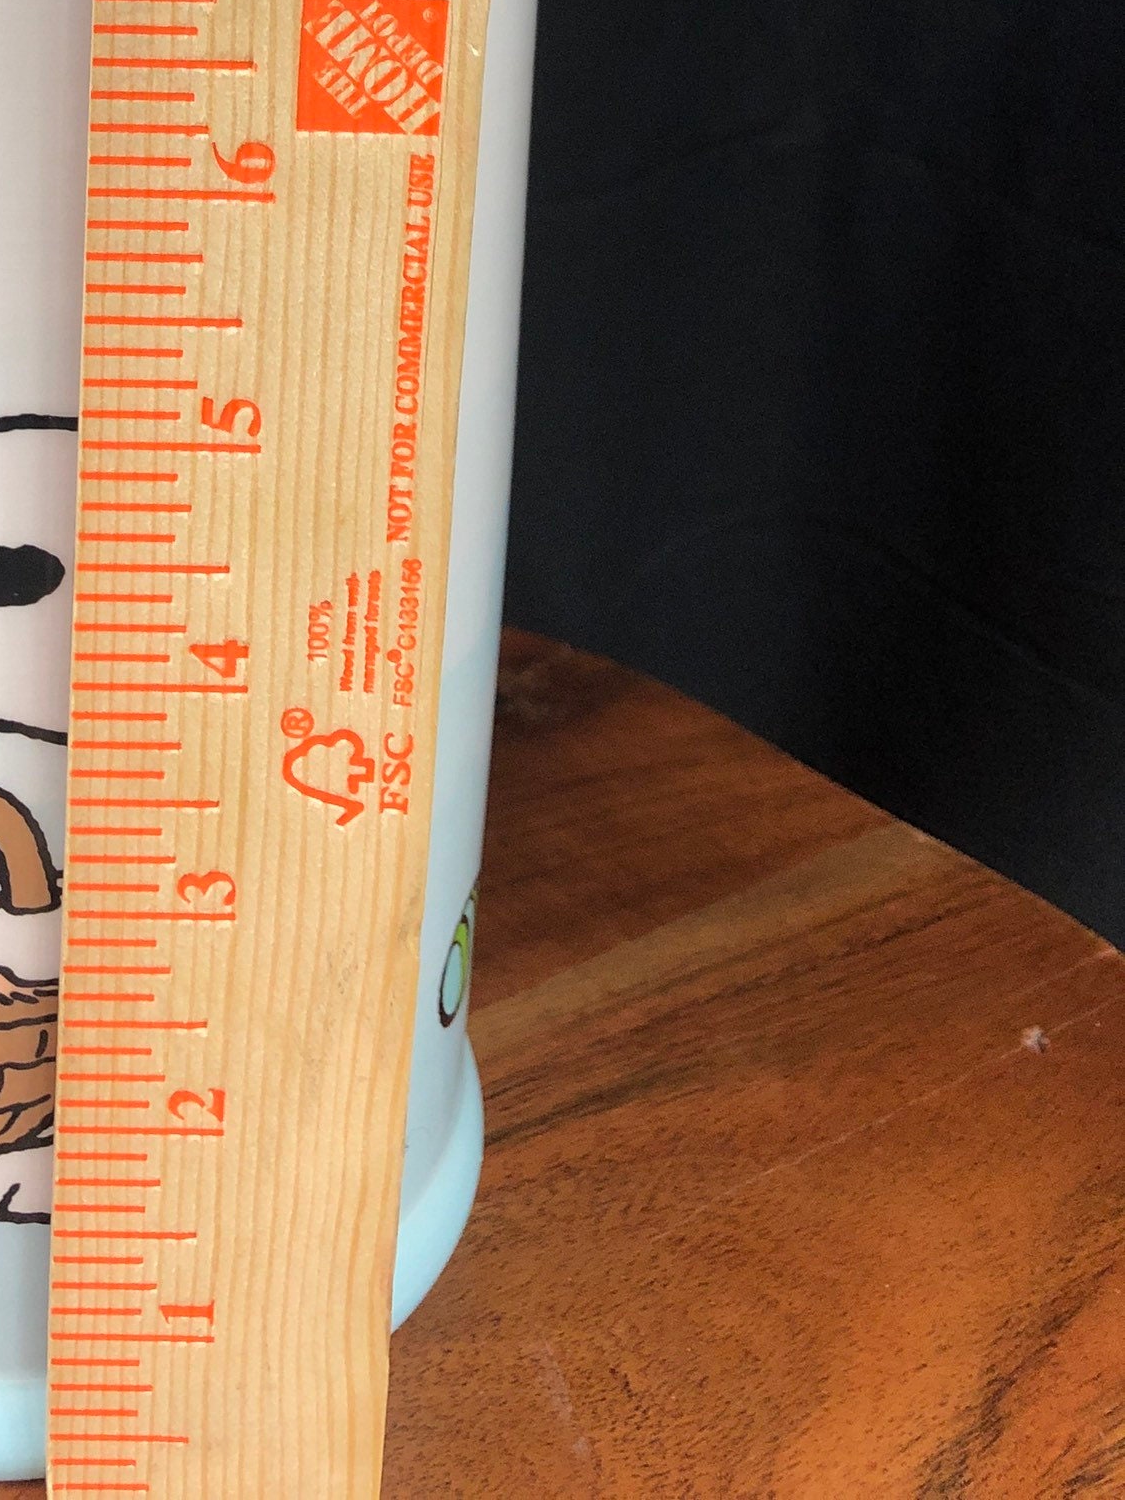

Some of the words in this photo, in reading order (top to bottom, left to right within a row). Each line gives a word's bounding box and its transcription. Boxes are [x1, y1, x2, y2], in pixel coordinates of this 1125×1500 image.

[304, 0, 440, 134] HOME
[357, 0, 443, 85] DEPOT
[314, 61, 369, 118] THE
[210, 139, 277, 187] 6
[405, 152, 436, 210] USE
[393, 215, 431, 416] COMMERCIAL
[200, 396, 262, 437] 5
[389, 422, 417, 479] FOR
[386, 483, 415, 543] NOT
[187, 637, 251, 680] 4
[306, 600, 335, 662] 100%
[378, 732, 415, 815] FSC
[174, 869, 239, 907] 3
[165, 1087, 227, 1127] 2
[157, 1297, 216, 1327] 1
